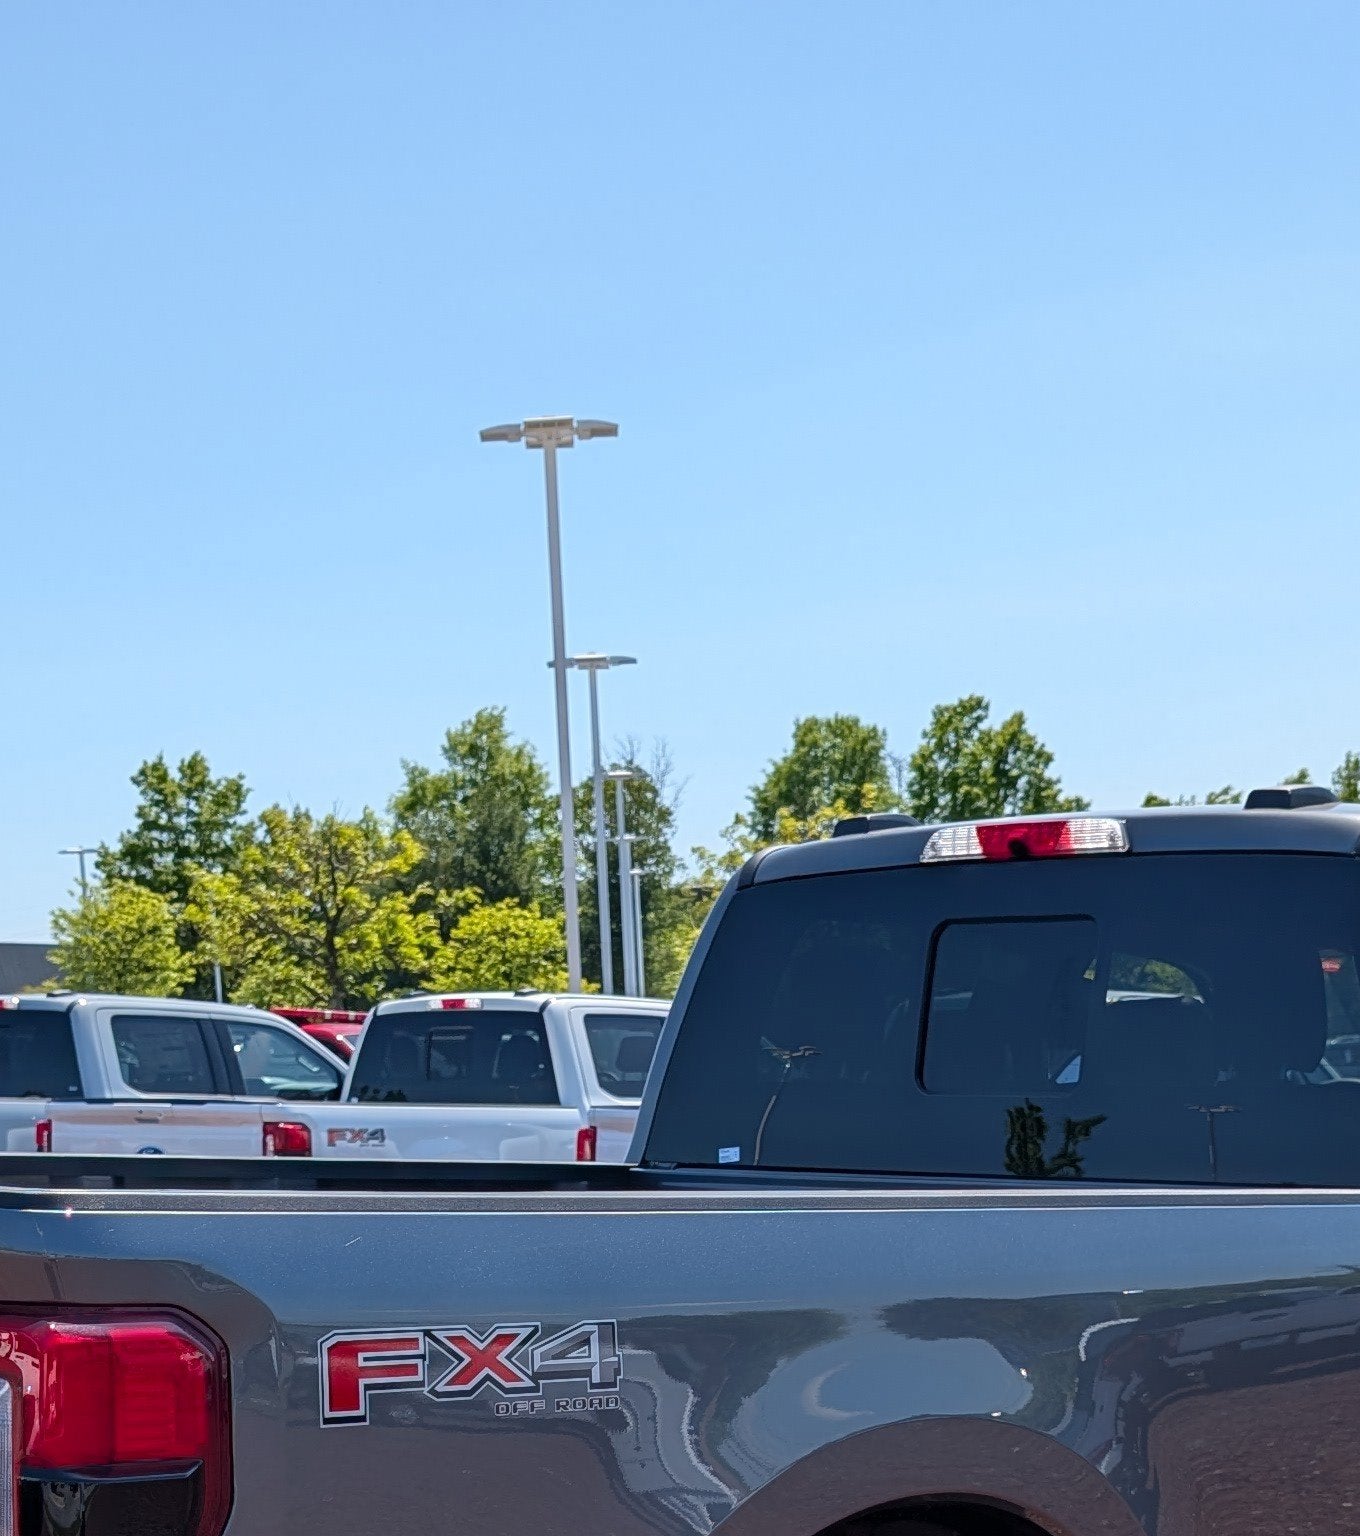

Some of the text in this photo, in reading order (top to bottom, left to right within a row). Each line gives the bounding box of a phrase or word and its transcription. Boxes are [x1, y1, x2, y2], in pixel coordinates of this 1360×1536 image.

[327, 1127, 386, 1147] FX4
[317, 1319, 624, 1428] FX4
[494, 1395, 620, 1416] OFF ROAD
